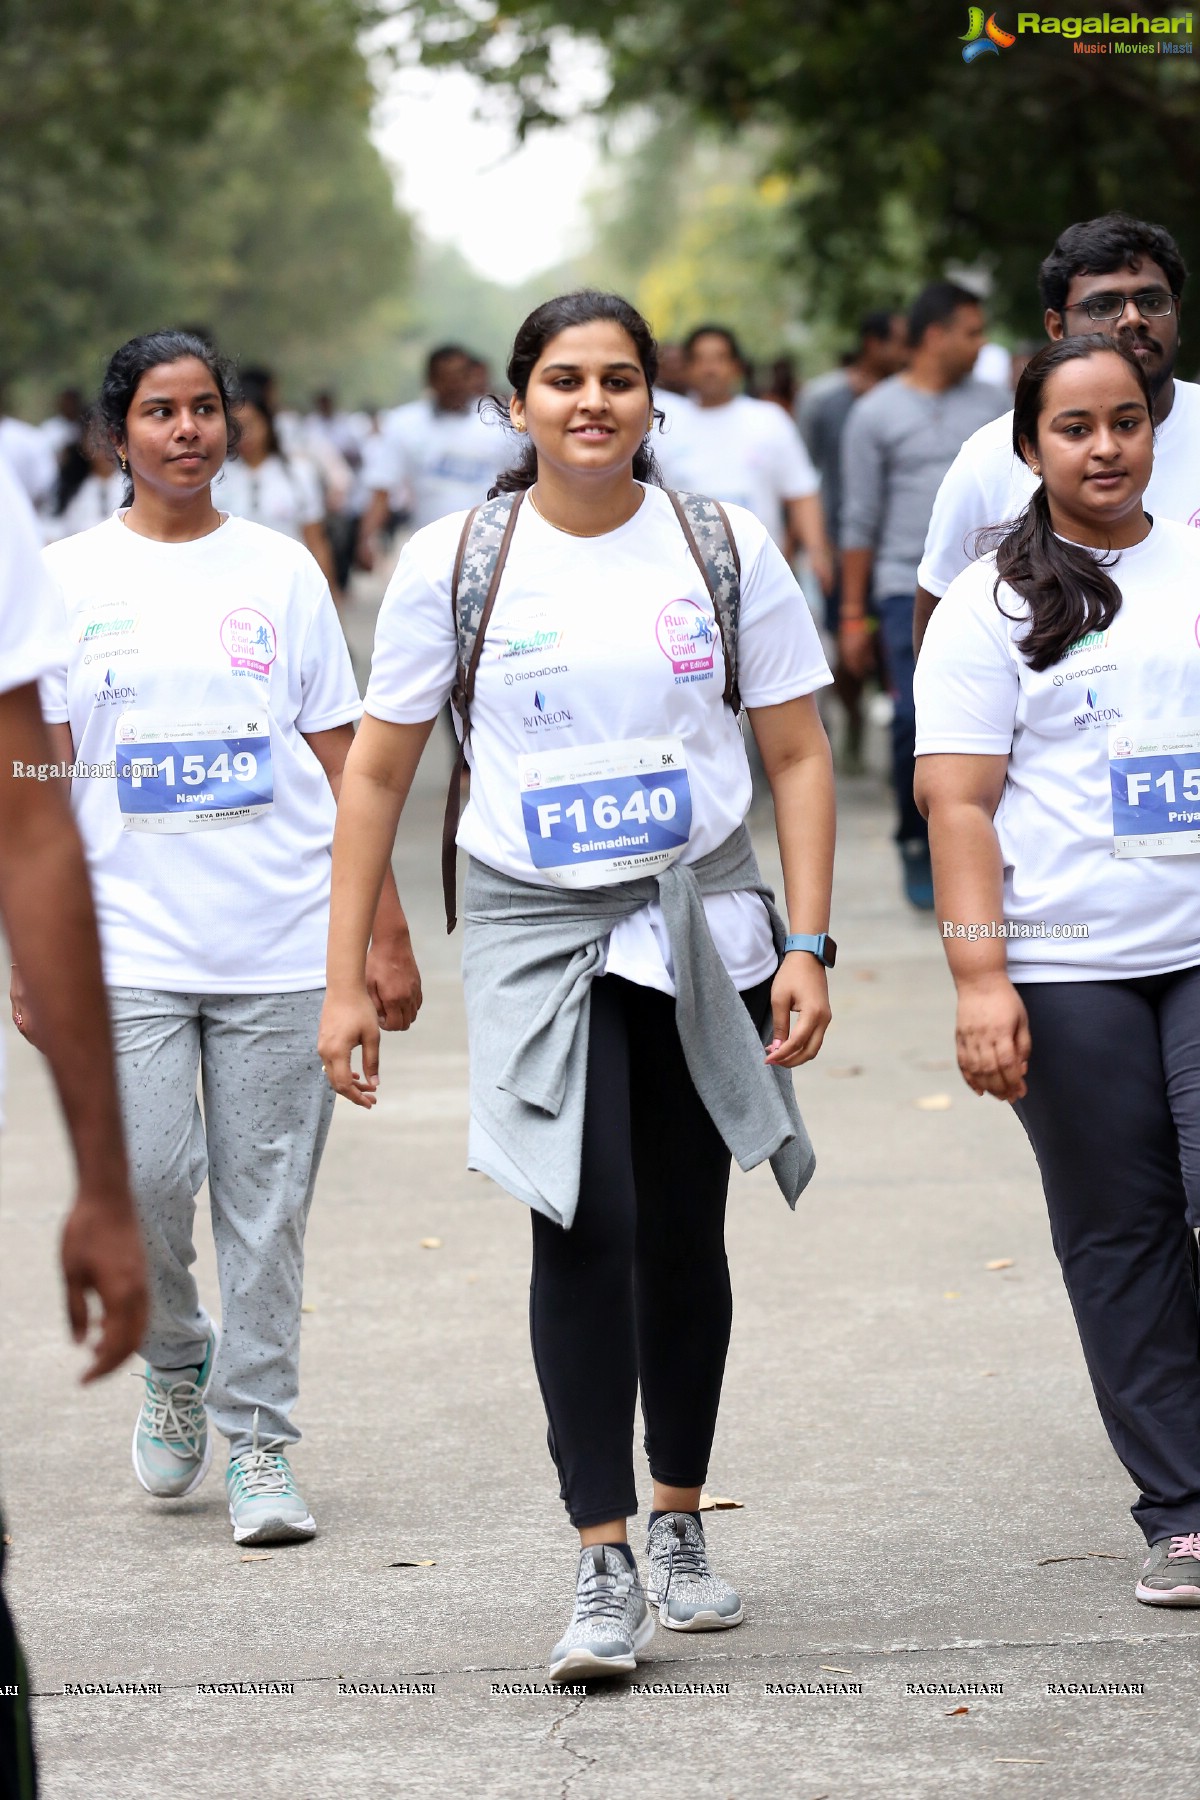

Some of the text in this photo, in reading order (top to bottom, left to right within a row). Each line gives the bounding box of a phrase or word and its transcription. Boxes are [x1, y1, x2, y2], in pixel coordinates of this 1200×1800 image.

[85, 618, 134, 636] Freedom
[230, 619, 252, 630] Run
[664, 615, 688, 627] Run
[677, 633, 689, 642] Girl
[94, 648, 139, 661] GlobalData
[231, 643, 254, 655] Child
[671, 642, 696, 656] Child
[689, 660, 710, 669] Edition
[515, 664, 568, 682] GlobalData
[1065, 664, 1118, 681] GlobalData
[674, 675, 689, 685] SEVA
[523, 709, 571, 728] AVINEON
[1074, 708, 1120, 727] AVINEON
[247, 722, 259, 732] 5K
[661, 754, 675, 765] 5K
[176, 792, 215, 804] Navya
[215, 808, 251, 818] BHARATHI
[536, 787, 677, 839] F1640
[572, 832, 649, 853] Saimadhuri
[613, 859, 632, 868] SEVA
[634, 852, 670, 865] BHARATHI
